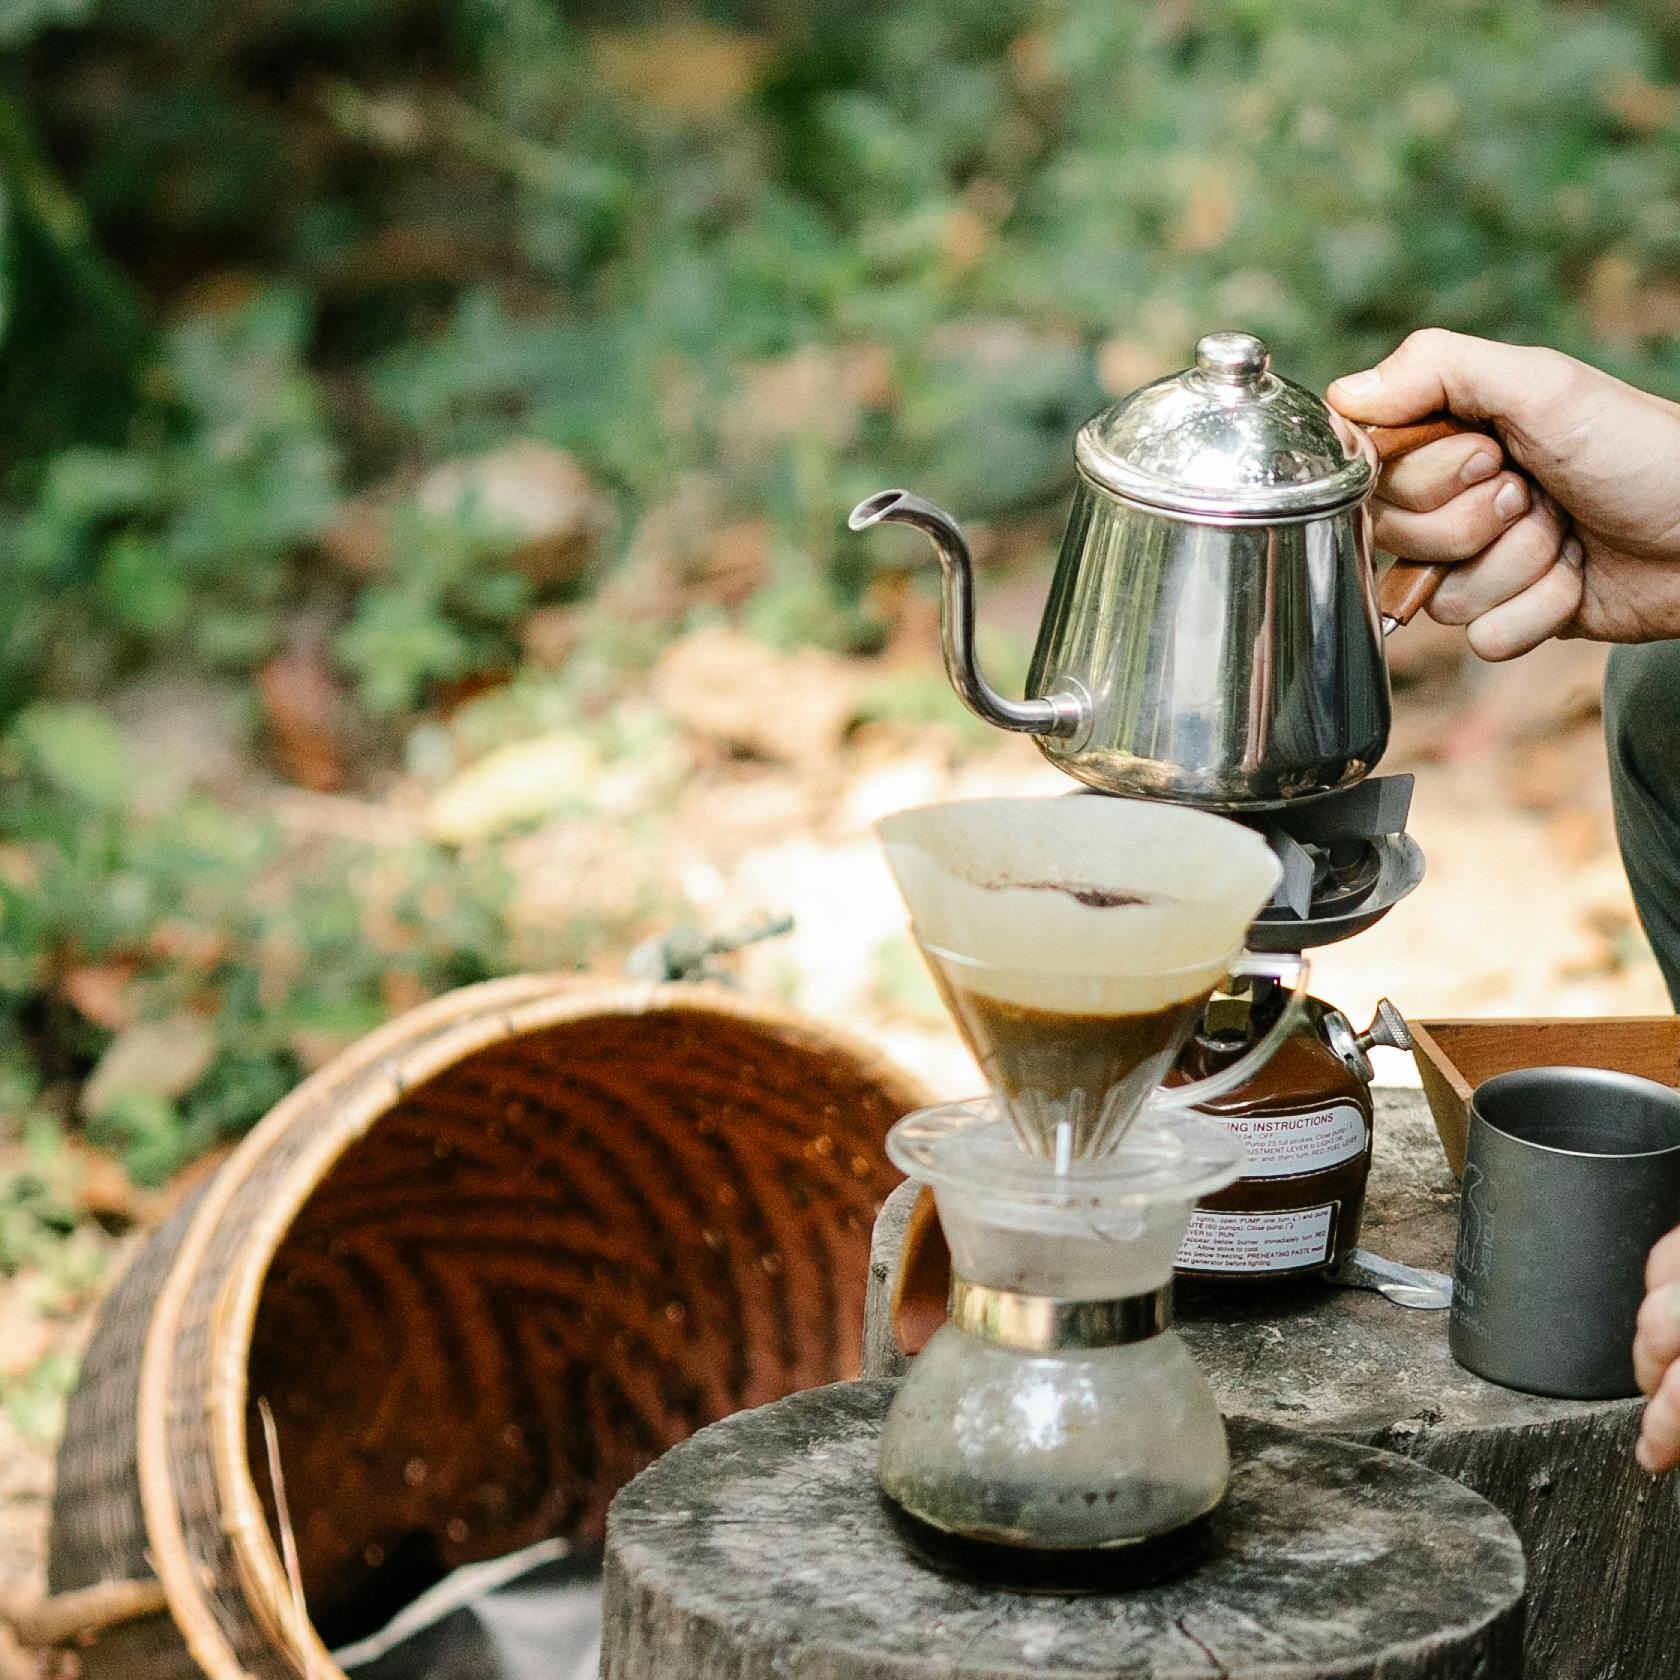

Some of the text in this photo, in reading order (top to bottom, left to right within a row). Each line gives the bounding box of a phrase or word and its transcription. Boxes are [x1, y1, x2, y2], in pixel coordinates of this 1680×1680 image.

[1253, 1113, 1333, 1131] INSTRUCTIONS
[1316, 1132, 1331, 1140] Close
[1286, 1144, 1309, 1153] LEVER
[1312, 1148, 1324, 1156] RED
[1327, 1144, 1341, 1152] FUEL
[1342, 1135, 1358, 1147] LEVER
[1291, 1247, 1310, 1255] PASTE
